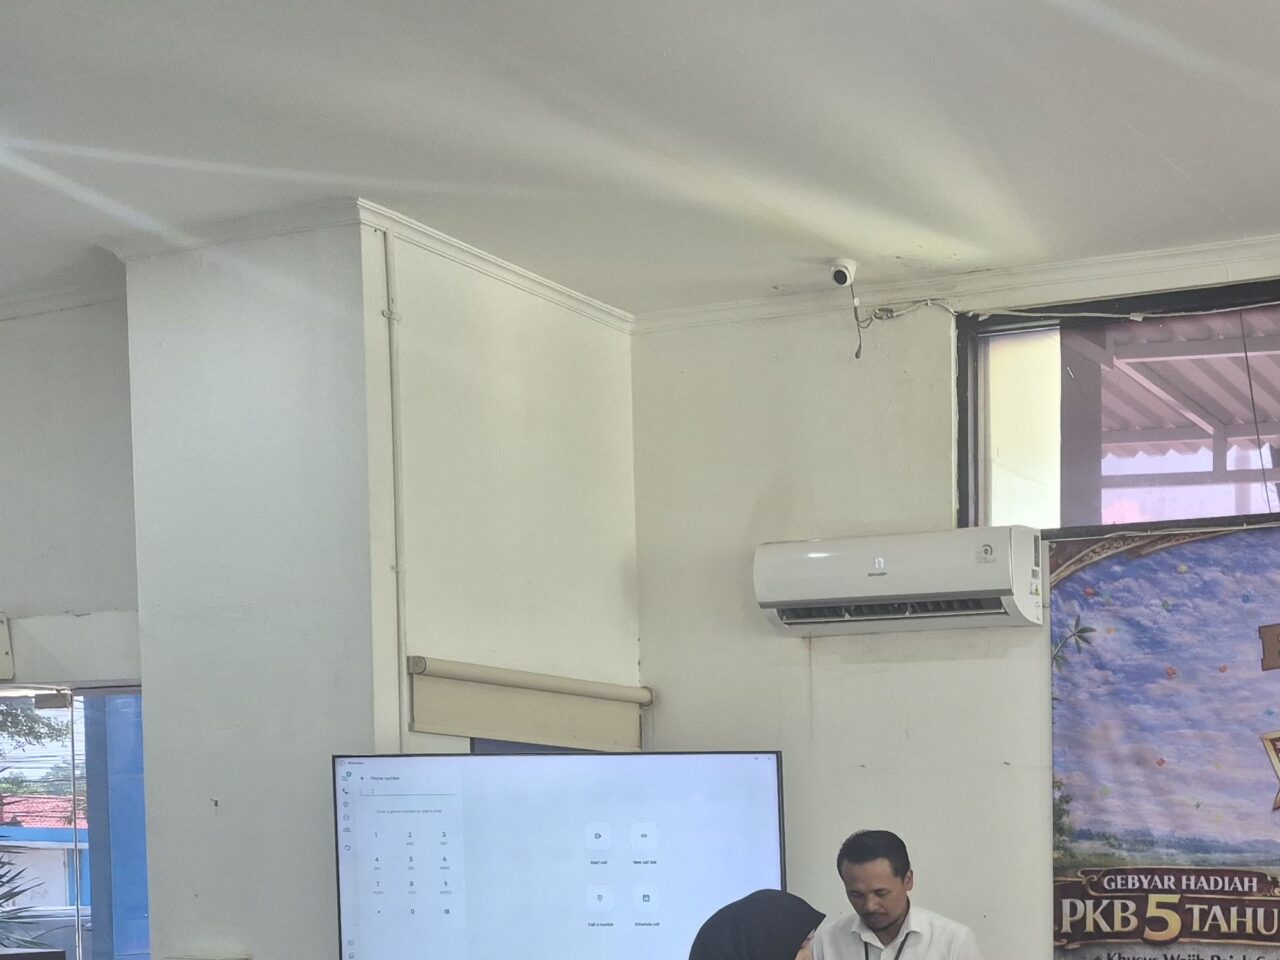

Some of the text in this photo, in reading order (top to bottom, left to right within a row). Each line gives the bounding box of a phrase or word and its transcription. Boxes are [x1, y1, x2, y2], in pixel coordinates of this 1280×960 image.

[1102, 875, 1258, 892] GEBYAR HADIAH
[1060, 898, 1140, 934] PKB
[1141, 894, 1183, 943] 5
